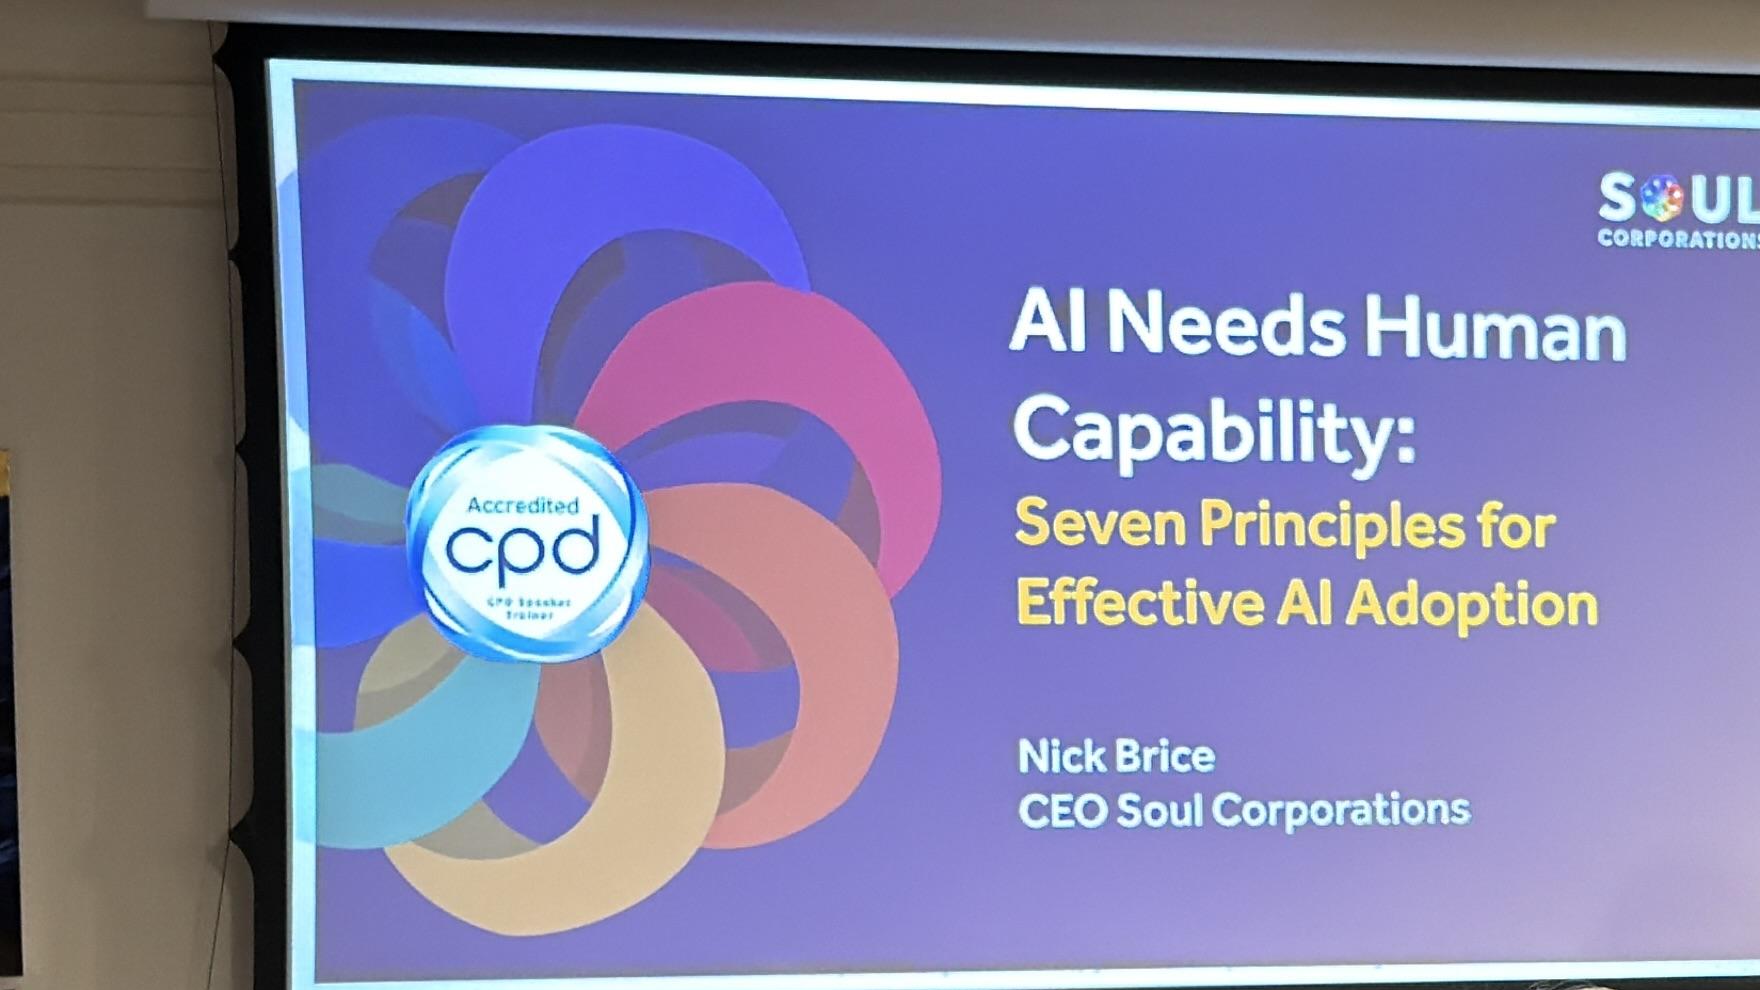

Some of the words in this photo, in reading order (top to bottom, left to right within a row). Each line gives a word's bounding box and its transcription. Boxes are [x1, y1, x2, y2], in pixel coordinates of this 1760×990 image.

[1008, 286, 1086, 353] AI
[1108, 287, 1347, 358] Needs
[1366, 293, 1628, 363] Human
[1012, 393, 1417, 482] Capability:
[468, 495, 579, 515] Accredited
[1014, 495, 1186, 548] Seven
[1201, 498, 1466, 560] Principles
[1476, 499, 1558, 549] for
[446, 513, 600, 589] cpd
[1016, 575, 1265, 627] Effective
[1276, 577, 1333, 627] AI
[1345, 578, 1599, 639] Adoption
[1018, 736, 1107, 775] Nick
[1115, 737, 1217, 775] Brice
[1018, 791, 1108, 829] CEO
[1115, 792, 1204, 830] Soul
[1210, 790, 1473, 836] Corporations
